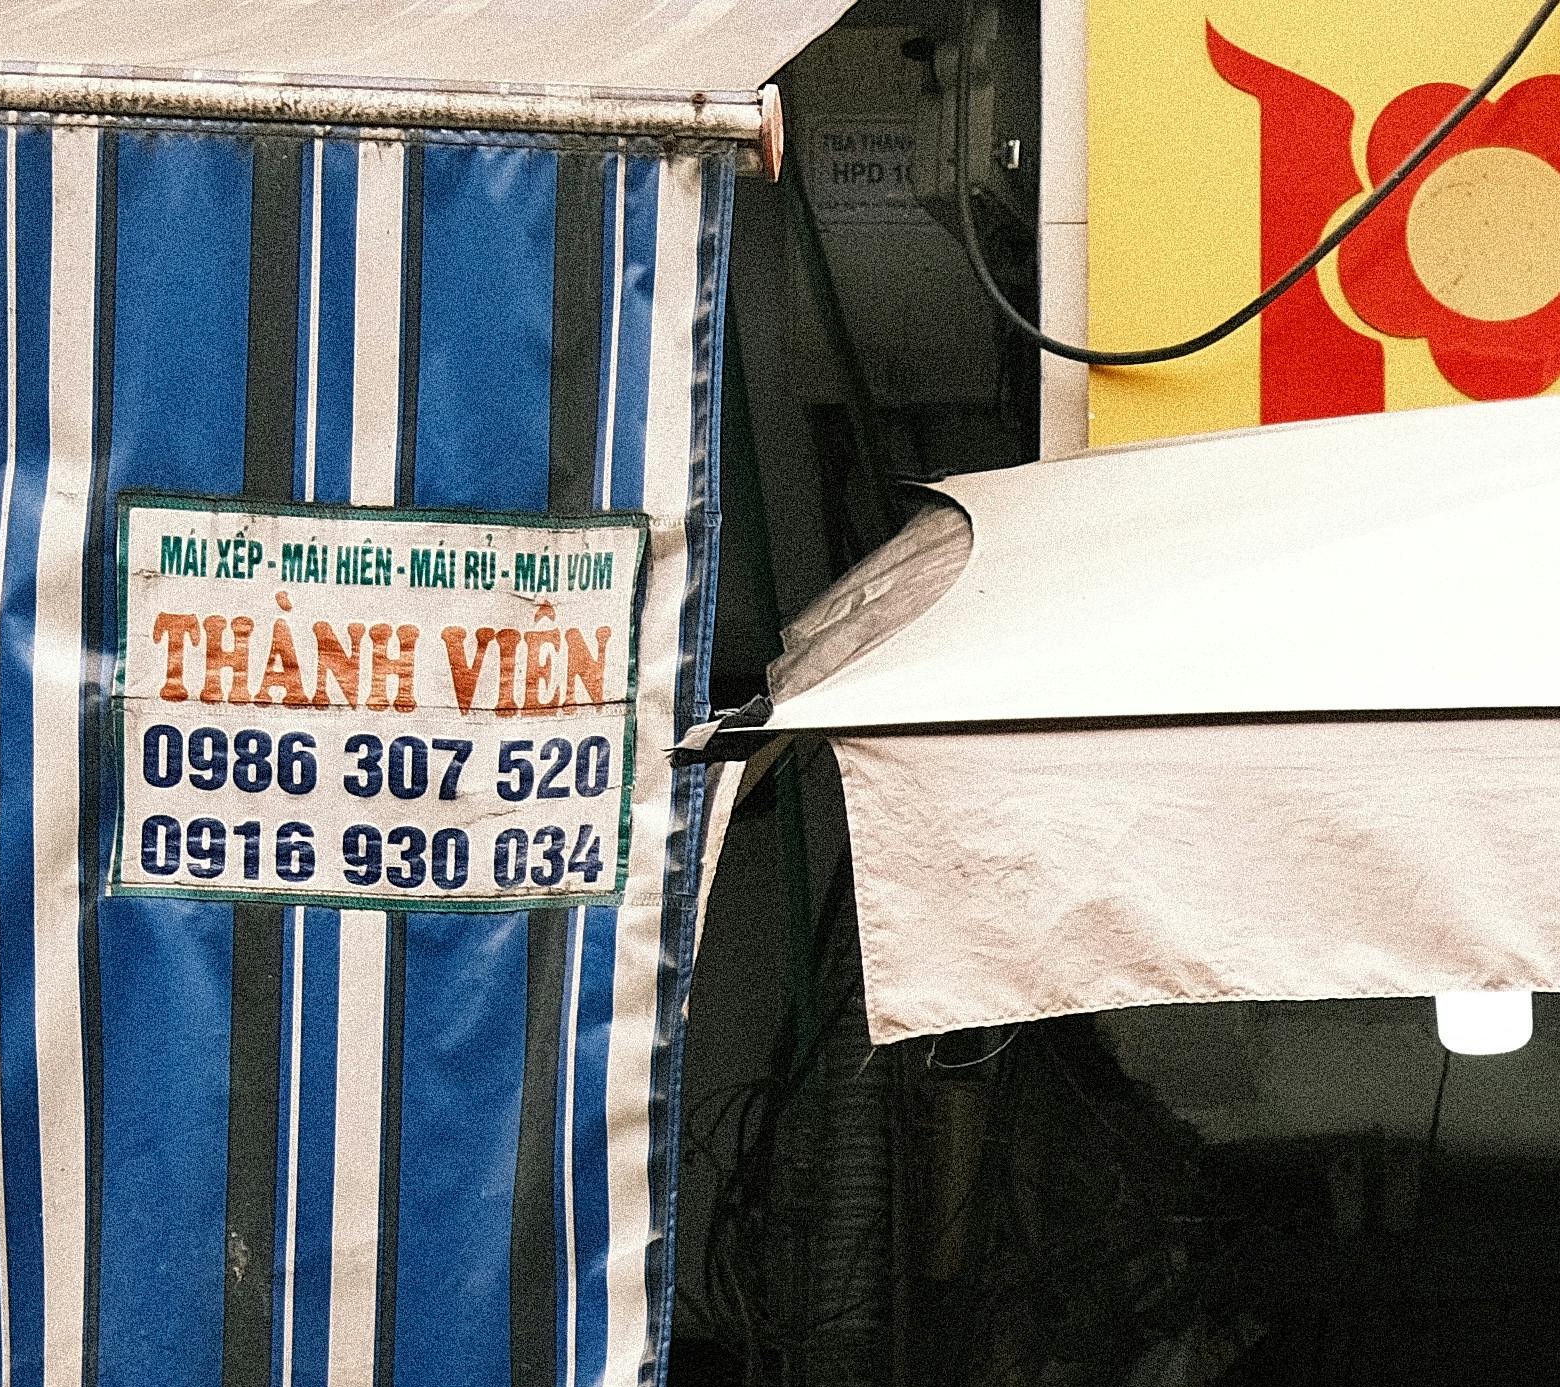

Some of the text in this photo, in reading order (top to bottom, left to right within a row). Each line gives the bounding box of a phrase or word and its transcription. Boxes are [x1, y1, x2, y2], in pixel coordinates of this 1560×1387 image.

[832, 162, 885, 184] HPD
[160, 529, 208, 579] MÁI
[215, 525, 263, 580] XẾP
[282, 535, 328, 584] MÁI
[336, 540, 392, 587] HIÊN
[410, 537, 456, 590] MÁI
[515, 542, 559, 592] MÁI
[152, 590, 421, 714] THÀNH
[142, 724, 611, 802] 0986 307 520
[140, 814, 604, 890] 0916 930 034
